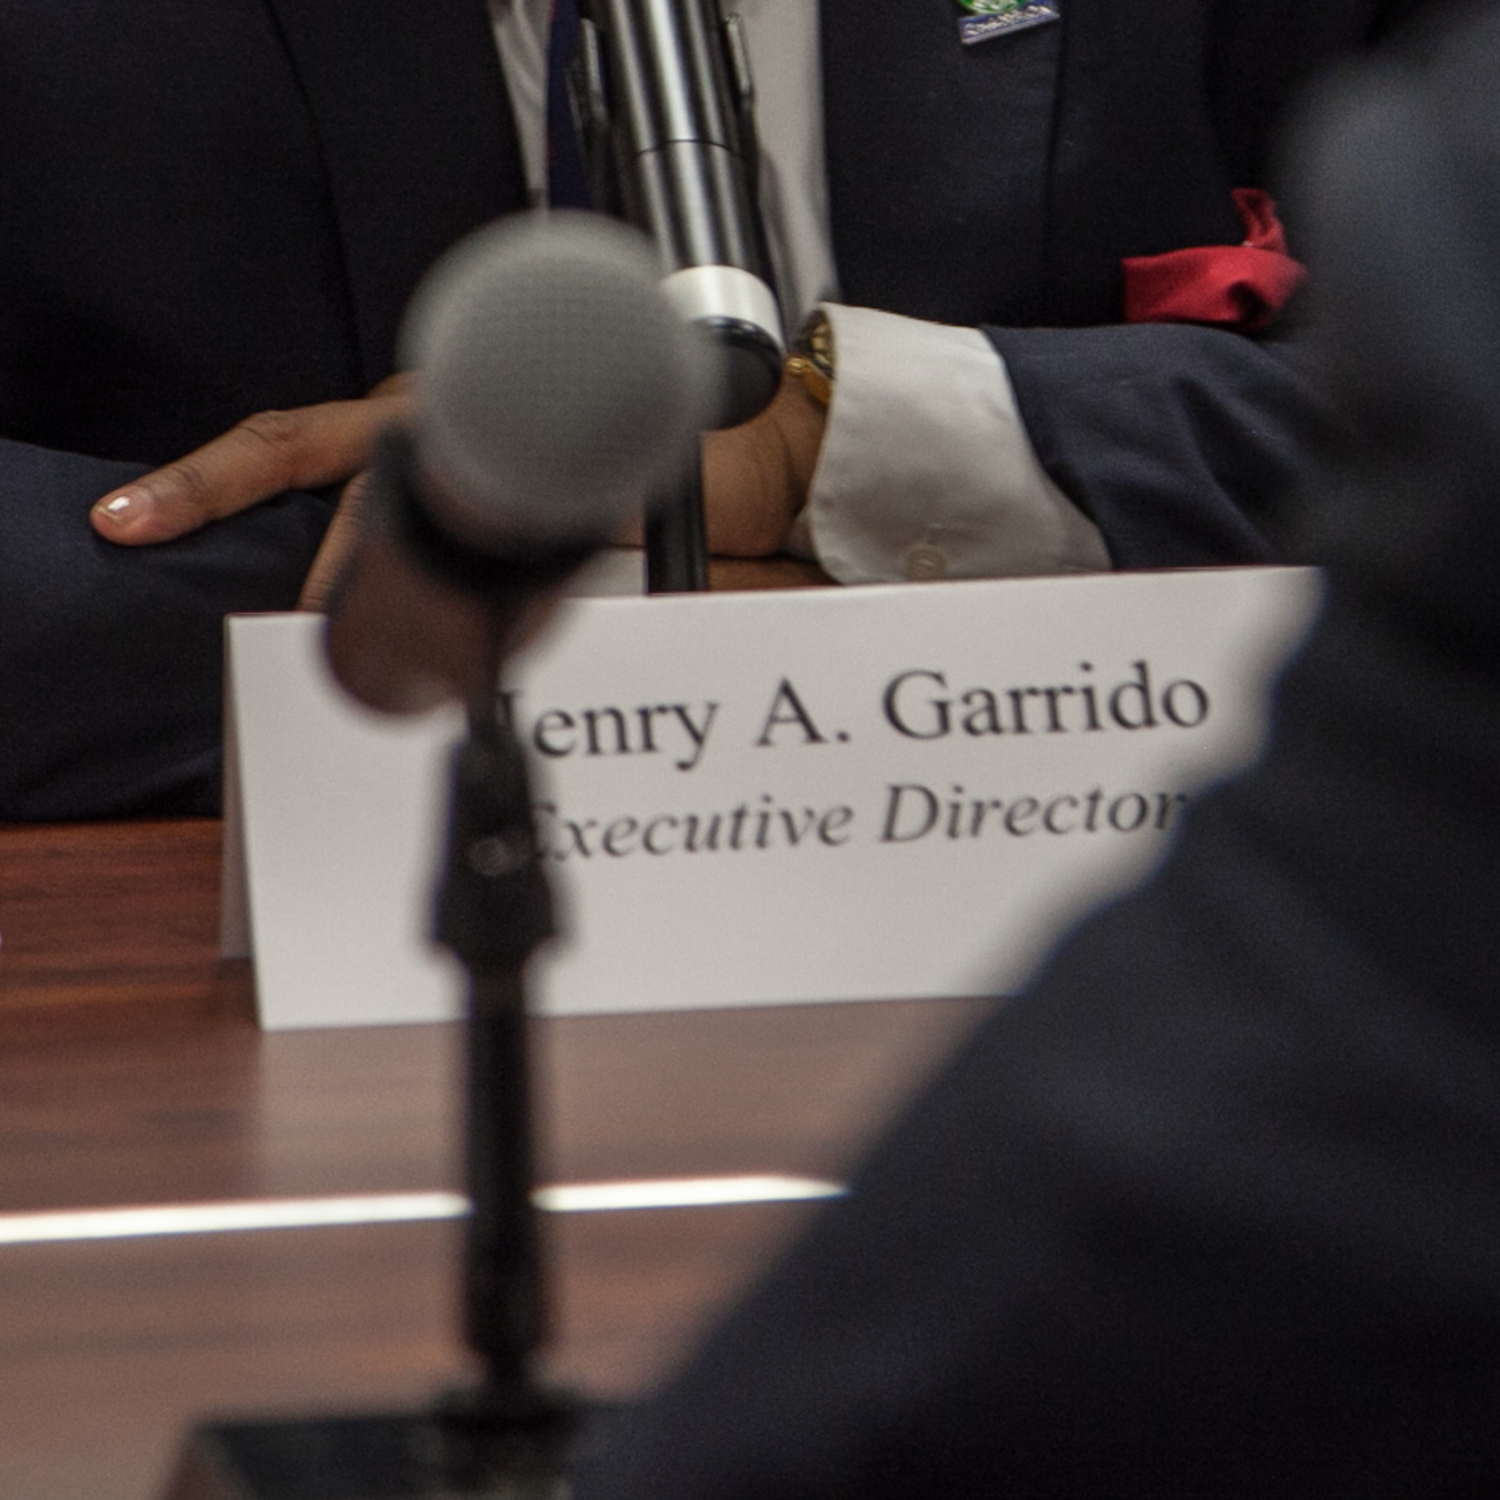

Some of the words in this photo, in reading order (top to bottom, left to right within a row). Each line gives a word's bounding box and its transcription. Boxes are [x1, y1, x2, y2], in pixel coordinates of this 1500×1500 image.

[754, 676, 850, 749] A.
[882, 659, 1211, 740] Garrido
[878, 782, 1188, 847] Director
